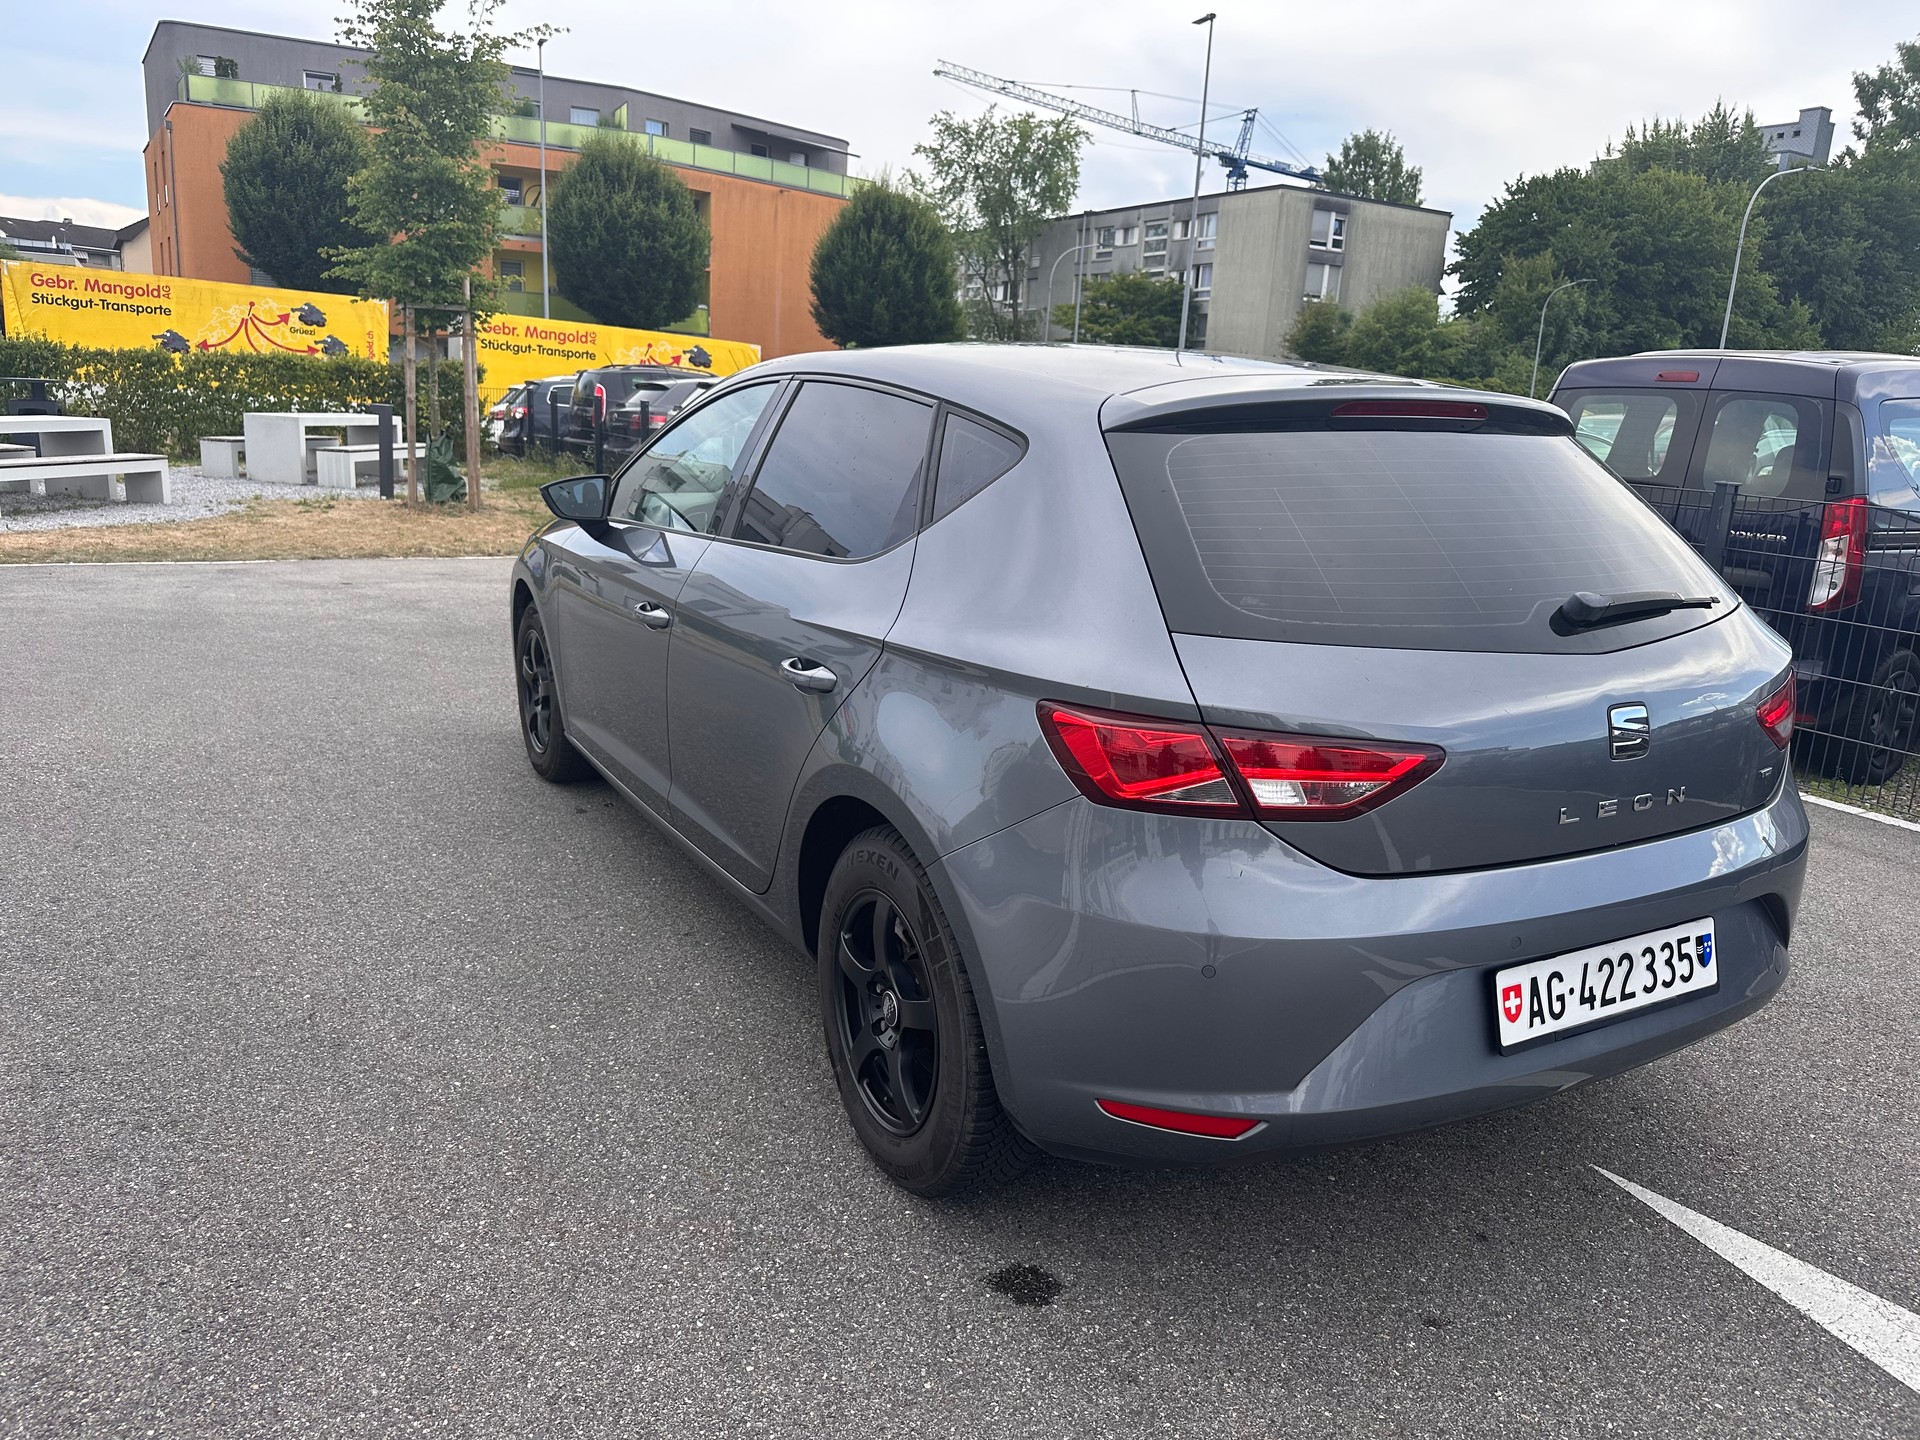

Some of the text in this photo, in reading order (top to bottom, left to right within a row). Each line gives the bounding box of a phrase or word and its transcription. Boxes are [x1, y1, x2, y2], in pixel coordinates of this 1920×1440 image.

[30, 273, 161, 299] Gebr. Mangold
[162, 285, 171, 299] AG
[31, 292, 172, 316] Stückgut-Transporte
[289, 326, 316, 336] Grüezi
[524, 325, 588, 345] Mangold
[588, 331, 597, 345] AG
[481, 338, 597, 361] Stückgut-Transporte
[1558, 785, 1687, 825] LEON
